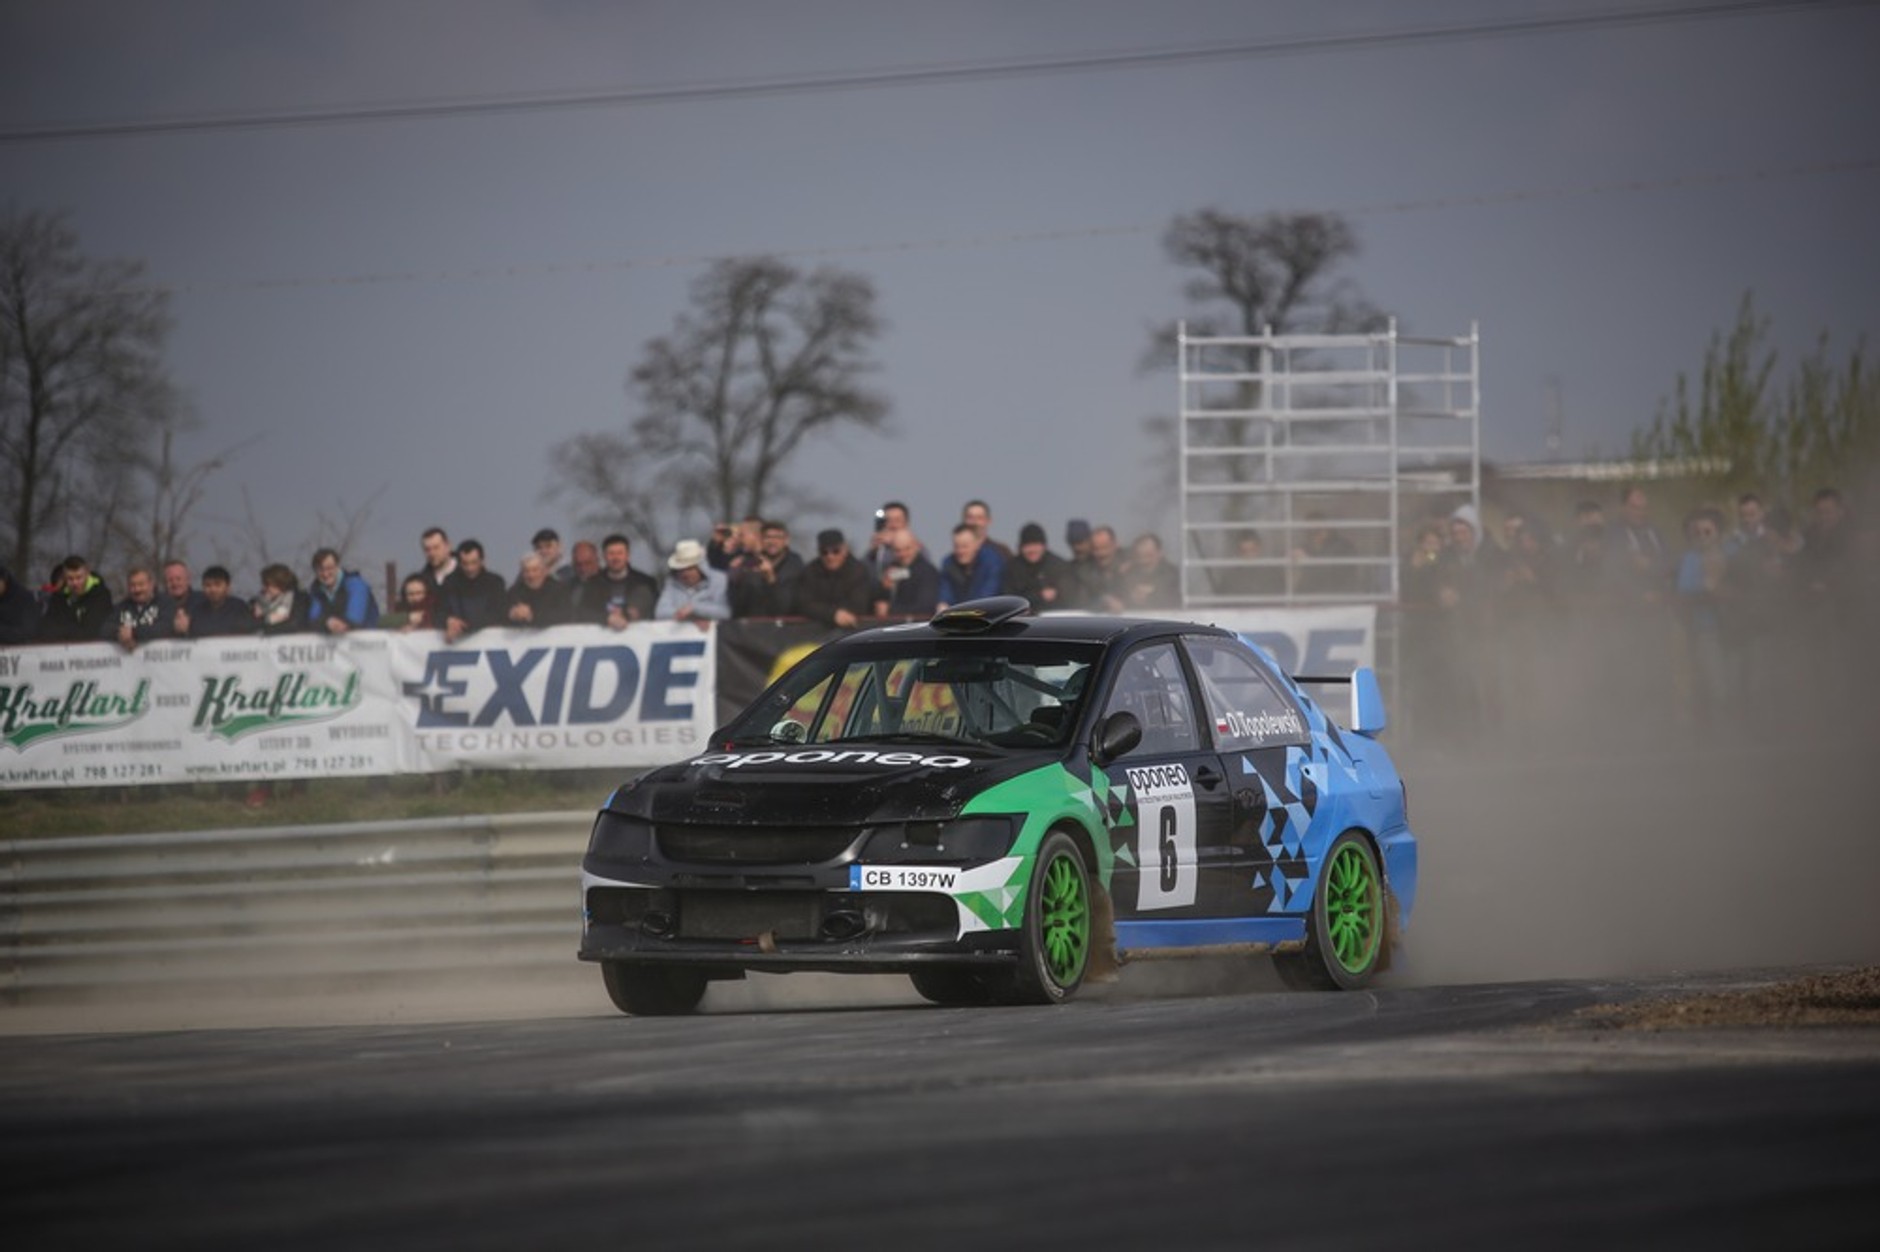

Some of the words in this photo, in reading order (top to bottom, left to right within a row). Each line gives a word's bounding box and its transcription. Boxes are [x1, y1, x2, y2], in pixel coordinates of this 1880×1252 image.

[193, 671, 358, 728] Kraftart
[404, 641, 706, 729] EXIDE
[414, 727, 696, 752] TECHNOLOGIES
[690, 749, 972, 768] oponeo
[1130, 765, 1188, 796] oponeo
[1159, 804, 1178, 893] 6
[866, 871, 892, 886] CB
[898, 872, 956, 888] 1397W
